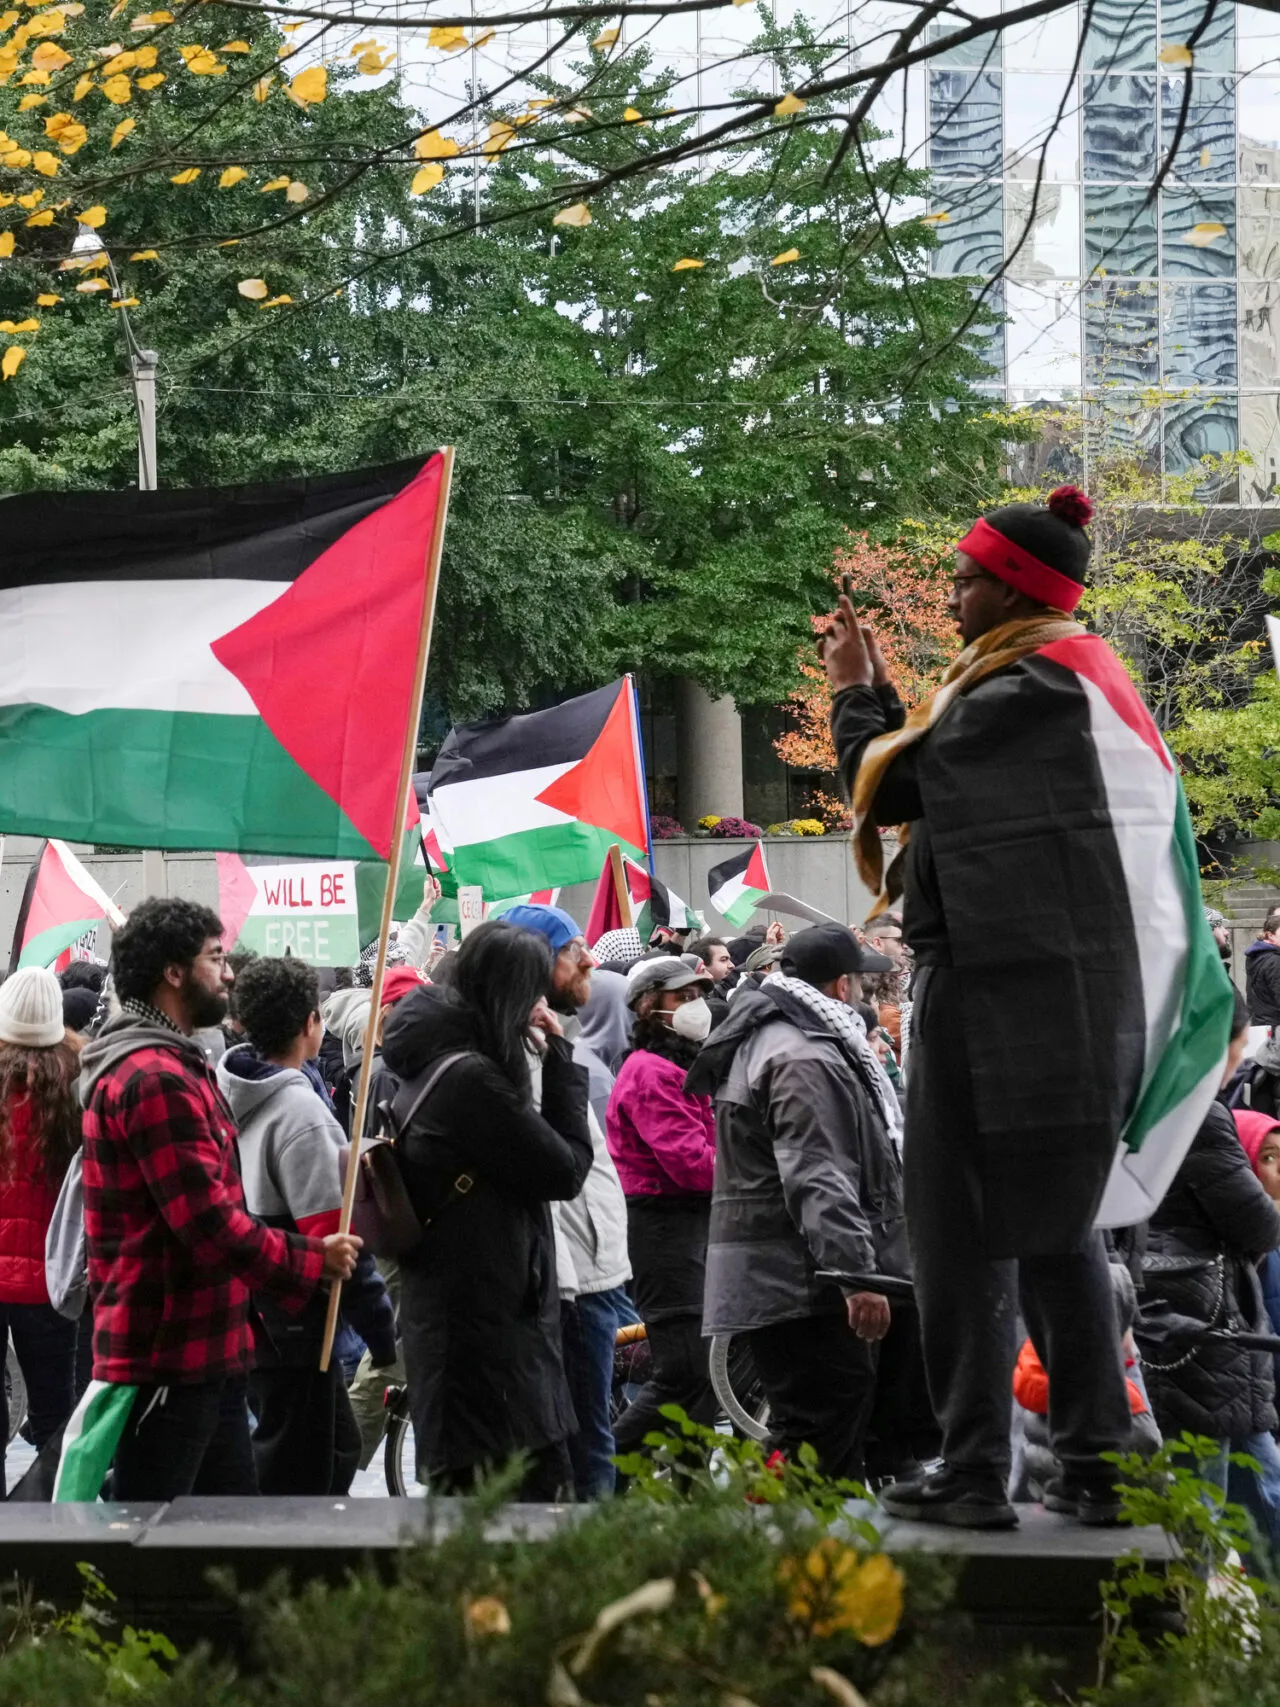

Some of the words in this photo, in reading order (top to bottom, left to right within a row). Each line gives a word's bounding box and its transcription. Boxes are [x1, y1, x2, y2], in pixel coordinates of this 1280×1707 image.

[263, 876, 313, 907] WILL
[320, 873, 346, 907] BE
[265, 920, 330, 961] FREE
